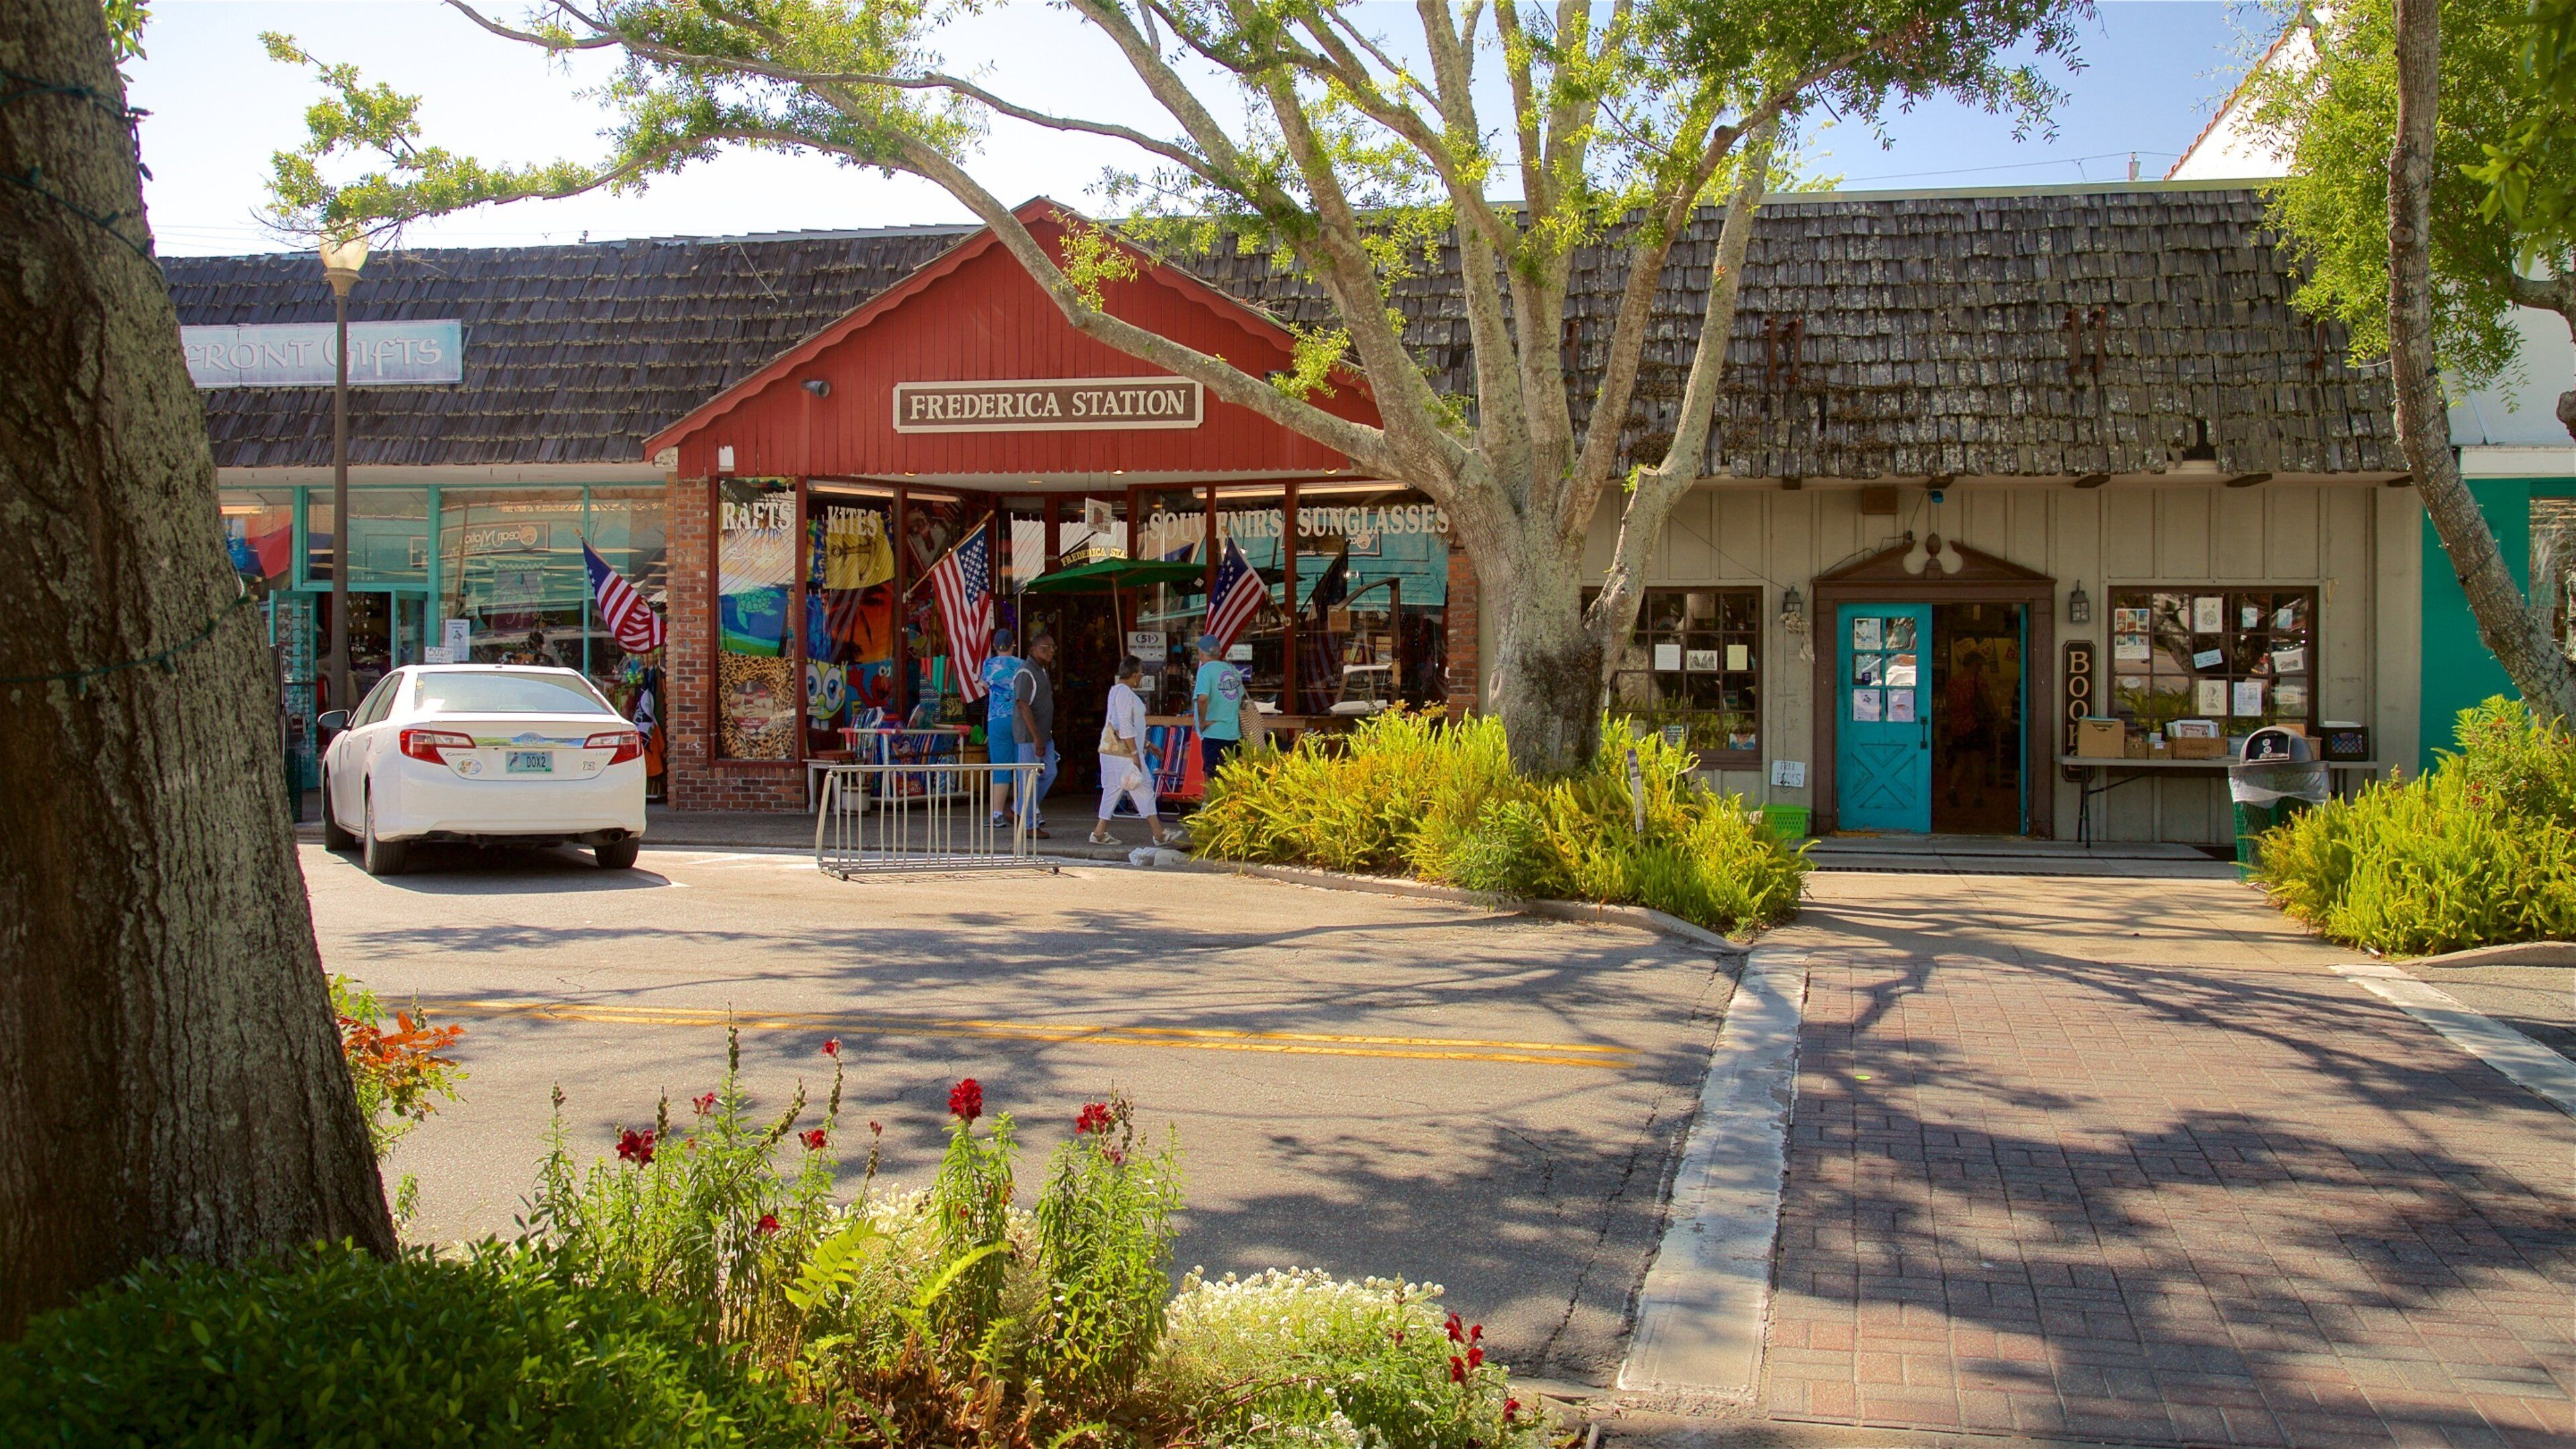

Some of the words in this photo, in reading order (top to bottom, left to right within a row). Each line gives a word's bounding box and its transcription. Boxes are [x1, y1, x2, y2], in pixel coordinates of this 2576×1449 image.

[910, 392, 1062, 420] FREDERICA
[1071, 389, 1187, 417] STATION
[722, 502, 792, 531] RAFTS
[826, 505, 878, 537] KITES
[1148, 508, 1284, 539] SOUVENIRS
[1297, 504, 1450, 537] SUNGLASSES
[1060, 547, 1107, 568] FREDERICA
